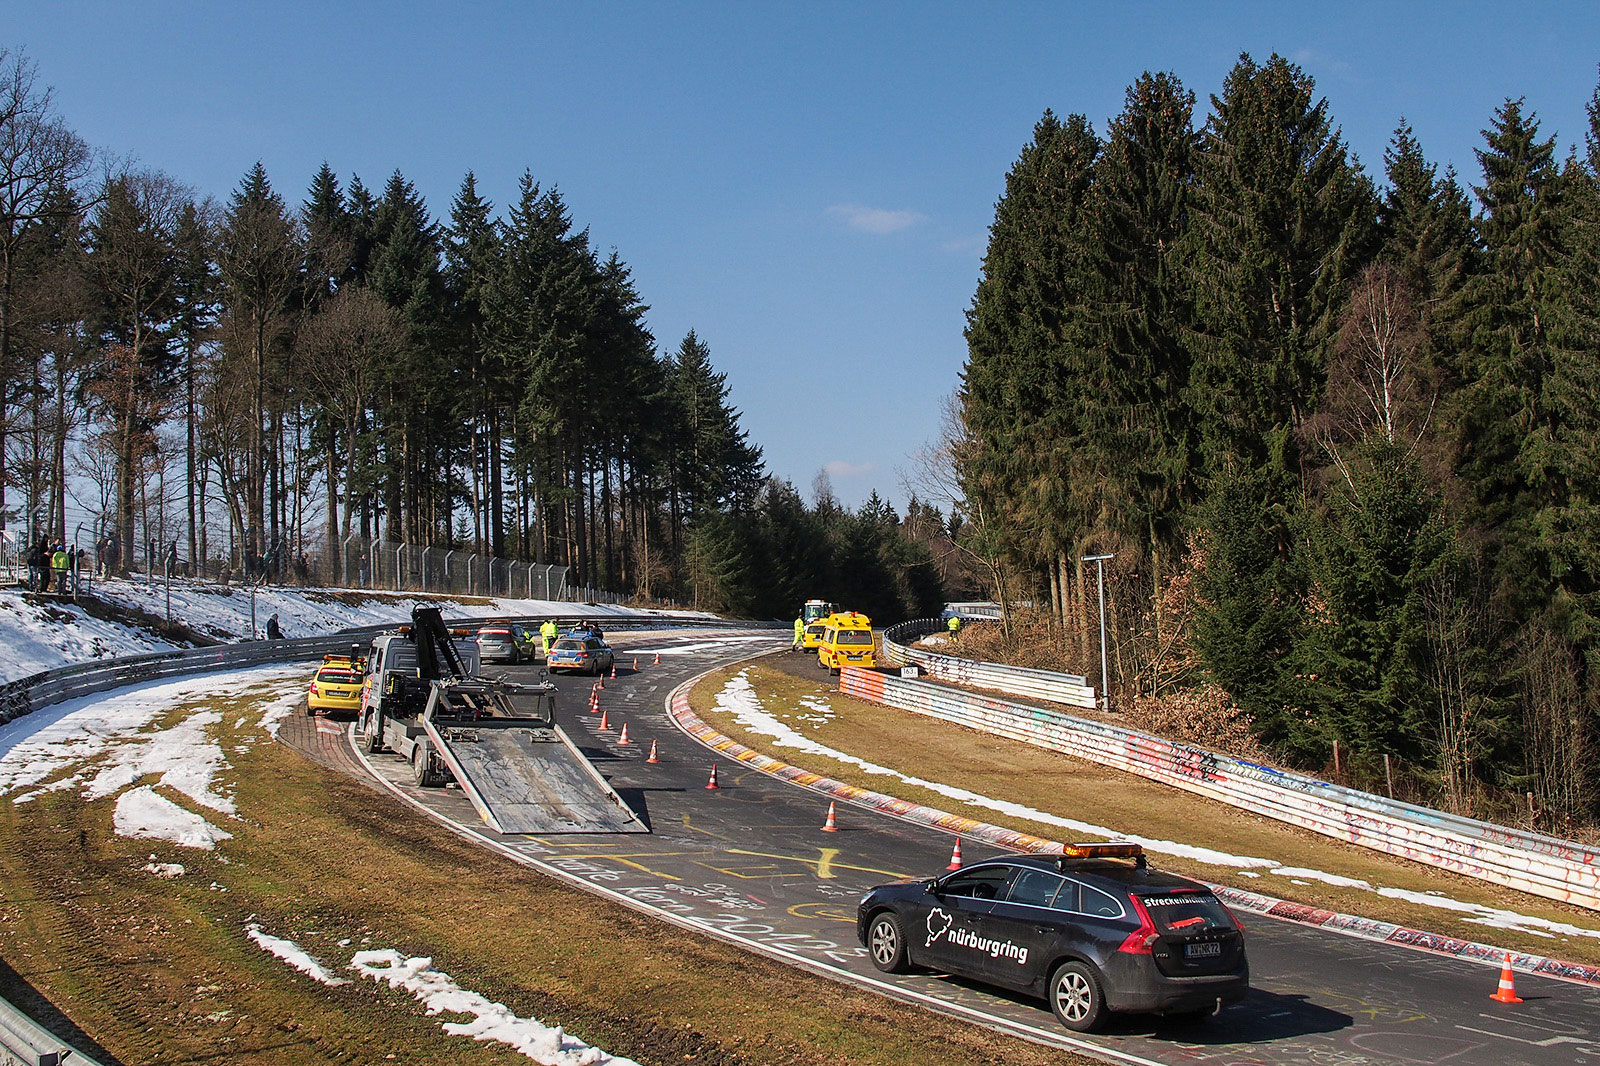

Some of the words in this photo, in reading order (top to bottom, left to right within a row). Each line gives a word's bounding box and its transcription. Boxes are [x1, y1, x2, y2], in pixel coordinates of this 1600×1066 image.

[616, 886, 695, 912] Kern
[687, 913, 838, 953] 2012
[947, 927, 1029, 965] nürburgring
